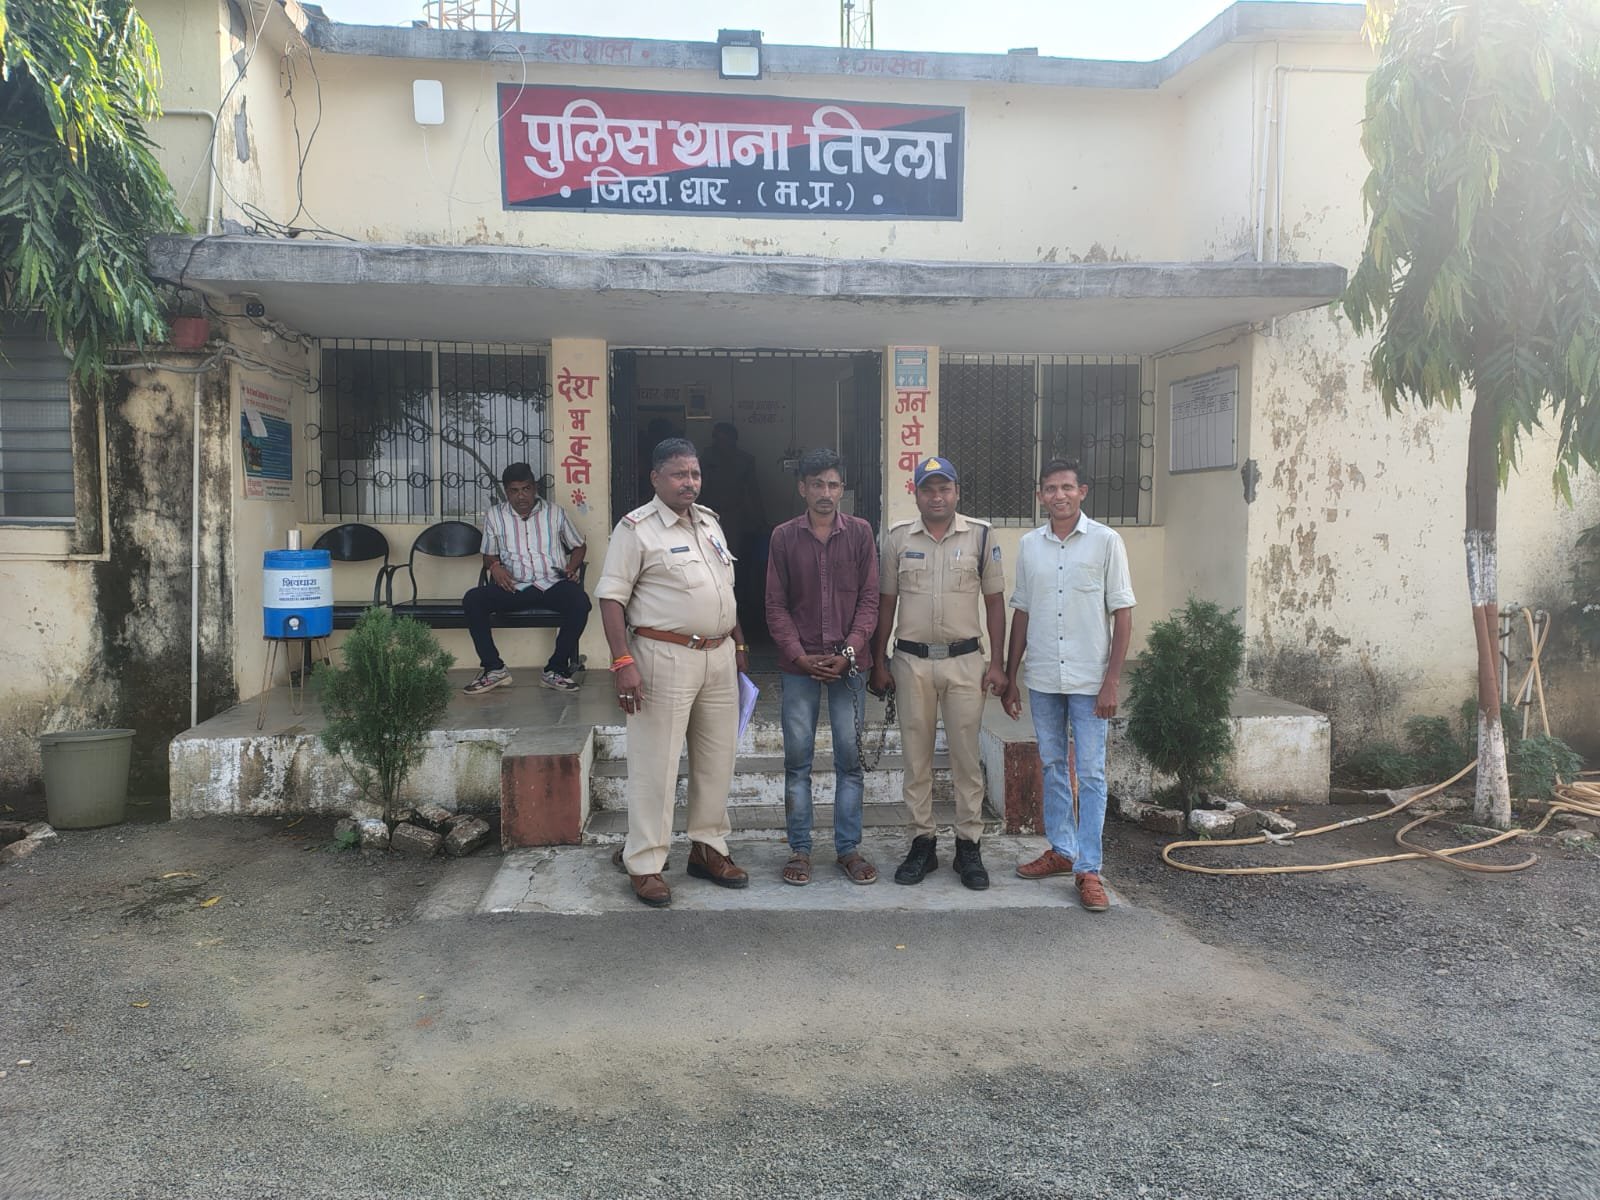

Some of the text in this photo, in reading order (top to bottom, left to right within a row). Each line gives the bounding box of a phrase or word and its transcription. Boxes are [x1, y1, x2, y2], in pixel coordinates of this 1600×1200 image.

[521, 99, 953, 181] पुलिस थाना तिरला
[557, 366, 600, 403] देश
[895, 390, 931, 415] जन
